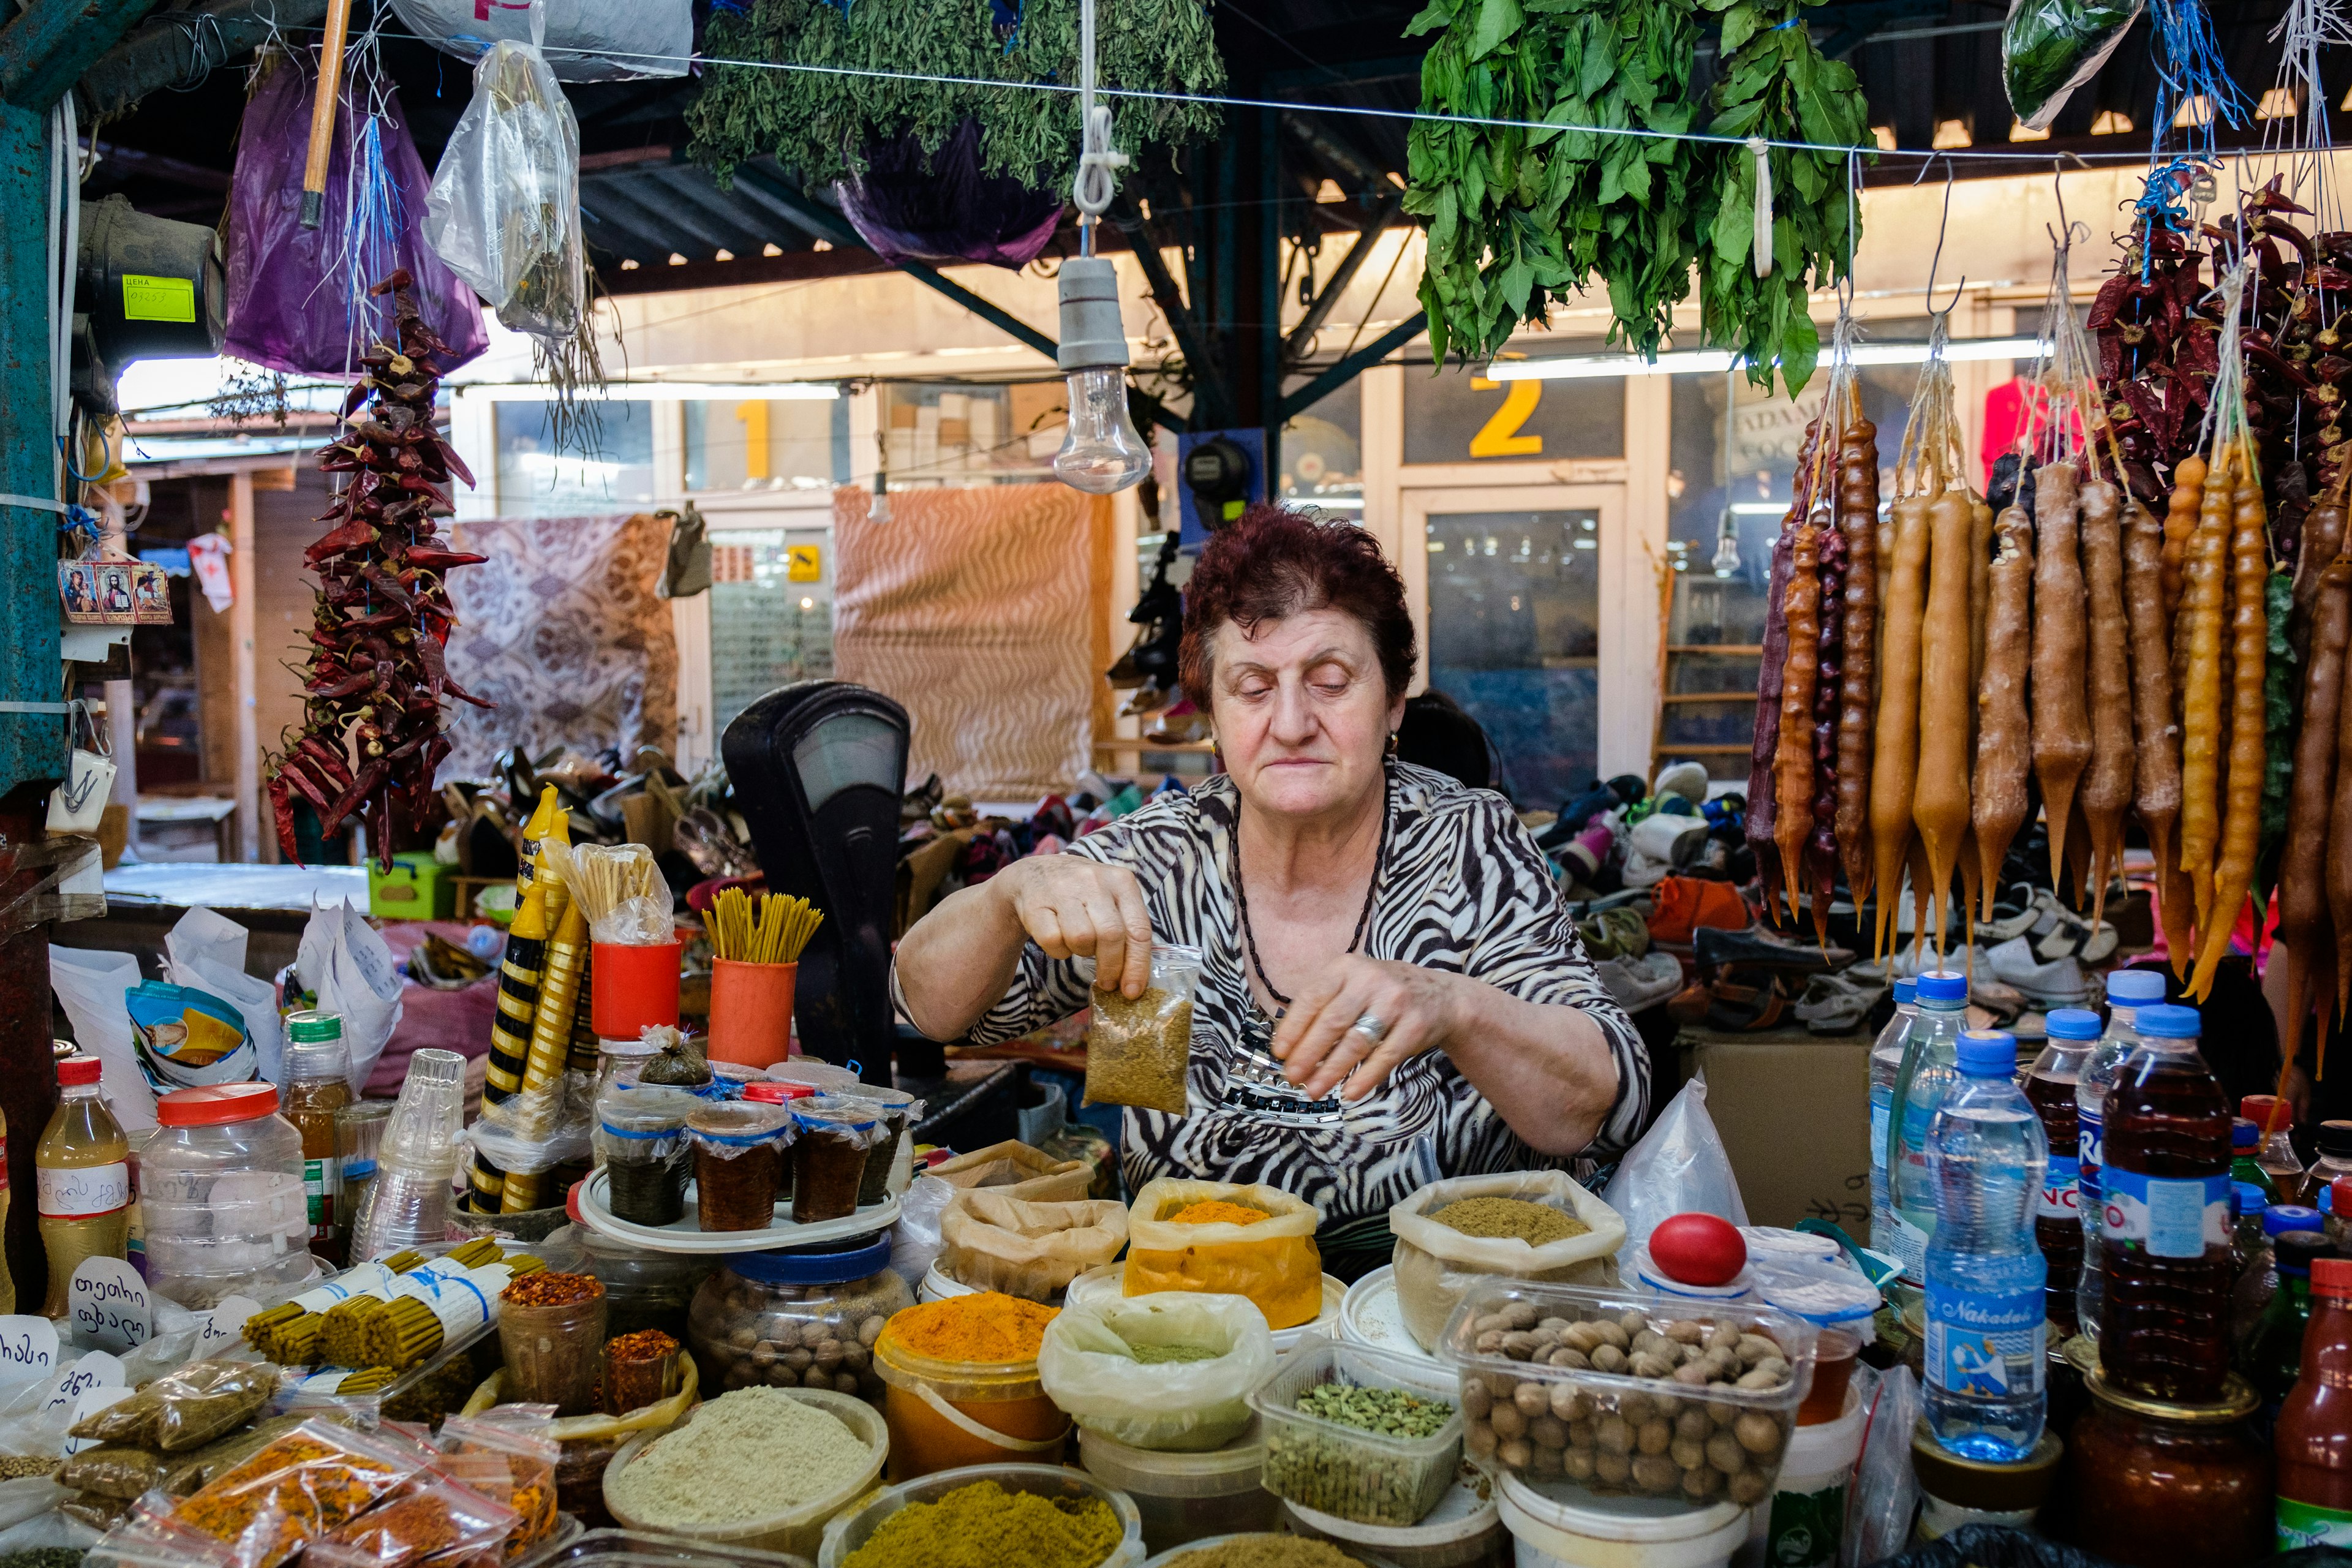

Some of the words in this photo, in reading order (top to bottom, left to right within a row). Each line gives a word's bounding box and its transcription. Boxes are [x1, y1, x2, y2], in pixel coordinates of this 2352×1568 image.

[736, 399, 769, 479] 1
[1469, 351, 1543, 458] 2
[75, 1275, 145, 1308] თეთრი
